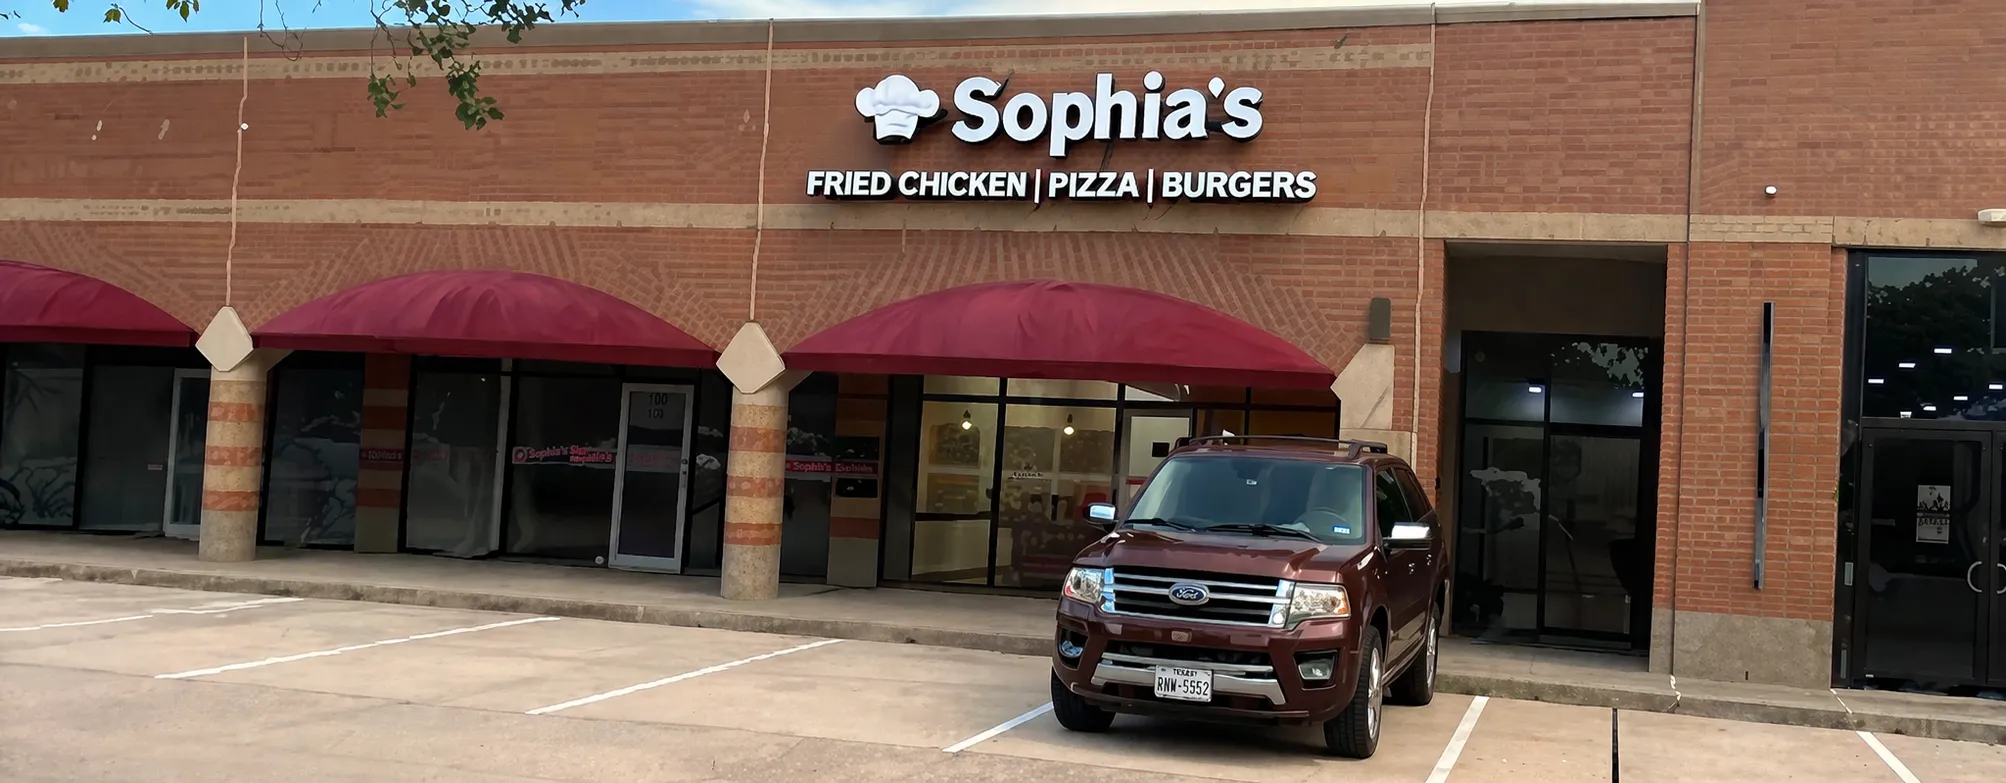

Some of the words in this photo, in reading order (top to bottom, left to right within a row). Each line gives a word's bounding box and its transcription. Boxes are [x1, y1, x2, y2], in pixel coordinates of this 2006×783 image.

[951, 70, 1263, 157] Sophia's
[806, 170, 892, 196] FRIED
[898, 170, 1027, 197] CHICKEN
[1048, 171, 1140, 198] PIZZA
[1162, 170, 1317, 199] BURGERS
[648, 392, 668, 406] 100
